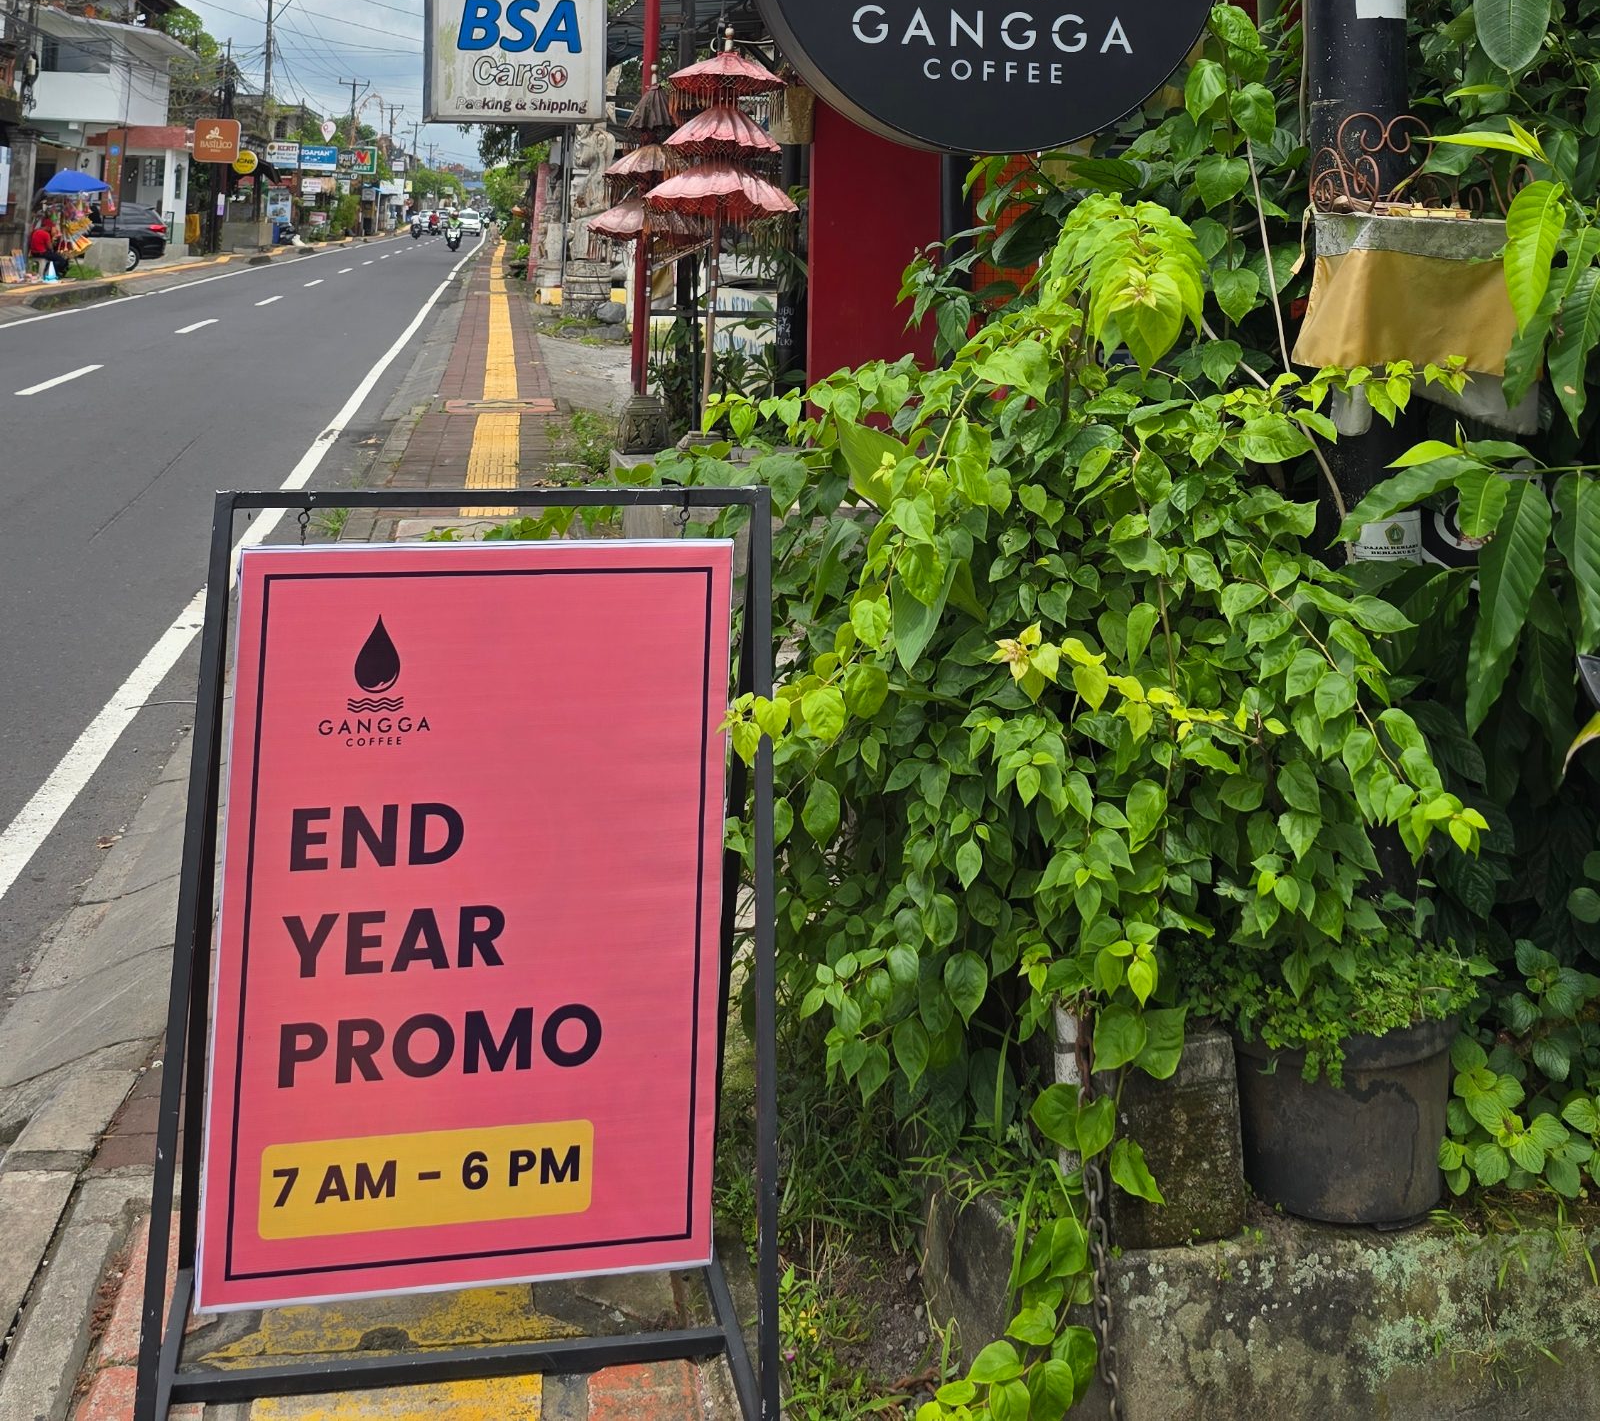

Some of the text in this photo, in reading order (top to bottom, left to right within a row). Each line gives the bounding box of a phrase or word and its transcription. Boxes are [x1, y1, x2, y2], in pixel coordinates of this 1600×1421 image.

[851, 3, 1134, 55] GANGGA
[472, 55, 569, 94] Cargo
[922, 57, 1064, 85] COFFEE
[456, 95, 588, 114] Packing & Shipping
[317, 716, 431, 736] GANGGA
[345, 736, 403, 748] COFFEE
[289, 802, 465, 872] END
[281, 904, 506, 979] YEAR
[277, 1003, 603, 1089] PROMO
[272, 1168, 300, 1208] 7
[314, 1159, 398, 1204] AM
[461, 1150, 490, 1191] 6
[508, 1145, 582, 1188] PM
